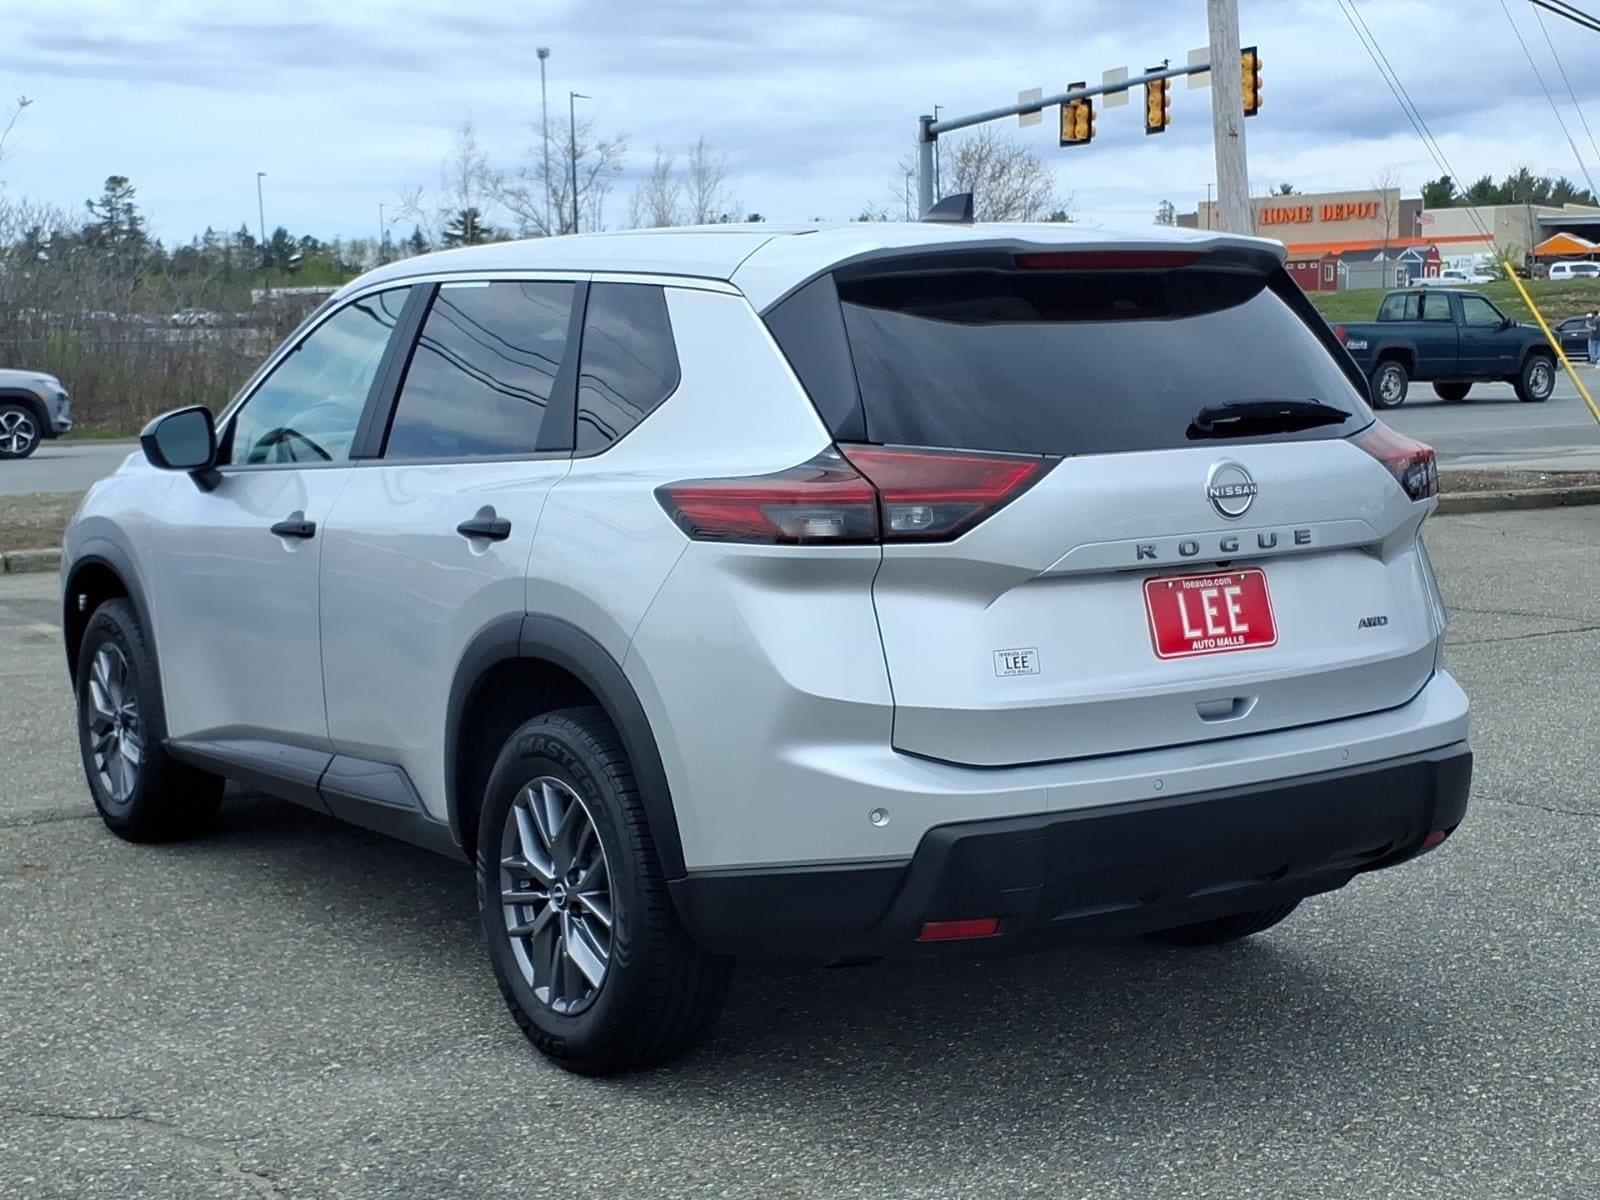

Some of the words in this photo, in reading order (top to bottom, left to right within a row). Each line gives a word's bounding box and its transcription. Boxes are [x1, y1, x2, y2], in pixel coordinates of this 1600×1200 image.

[1259, 206, 1313, 226] HOME
[1320, 202, 1379, 222] DEPOT
[1209, 485, 1257, 497] NISSAN
[1136, 528, 1312, 560] ROGUE
[1182, 576, 1232, 589] leeauto.com
[1176, 585, 1249, 639] LEE
[1358, 615, 1389, 629] AWD
[1192, 639, 1216, 650] AUTO
[1216, 635, 1245, 648] MALLS
[1005, 655, 1029, 670] LEE
